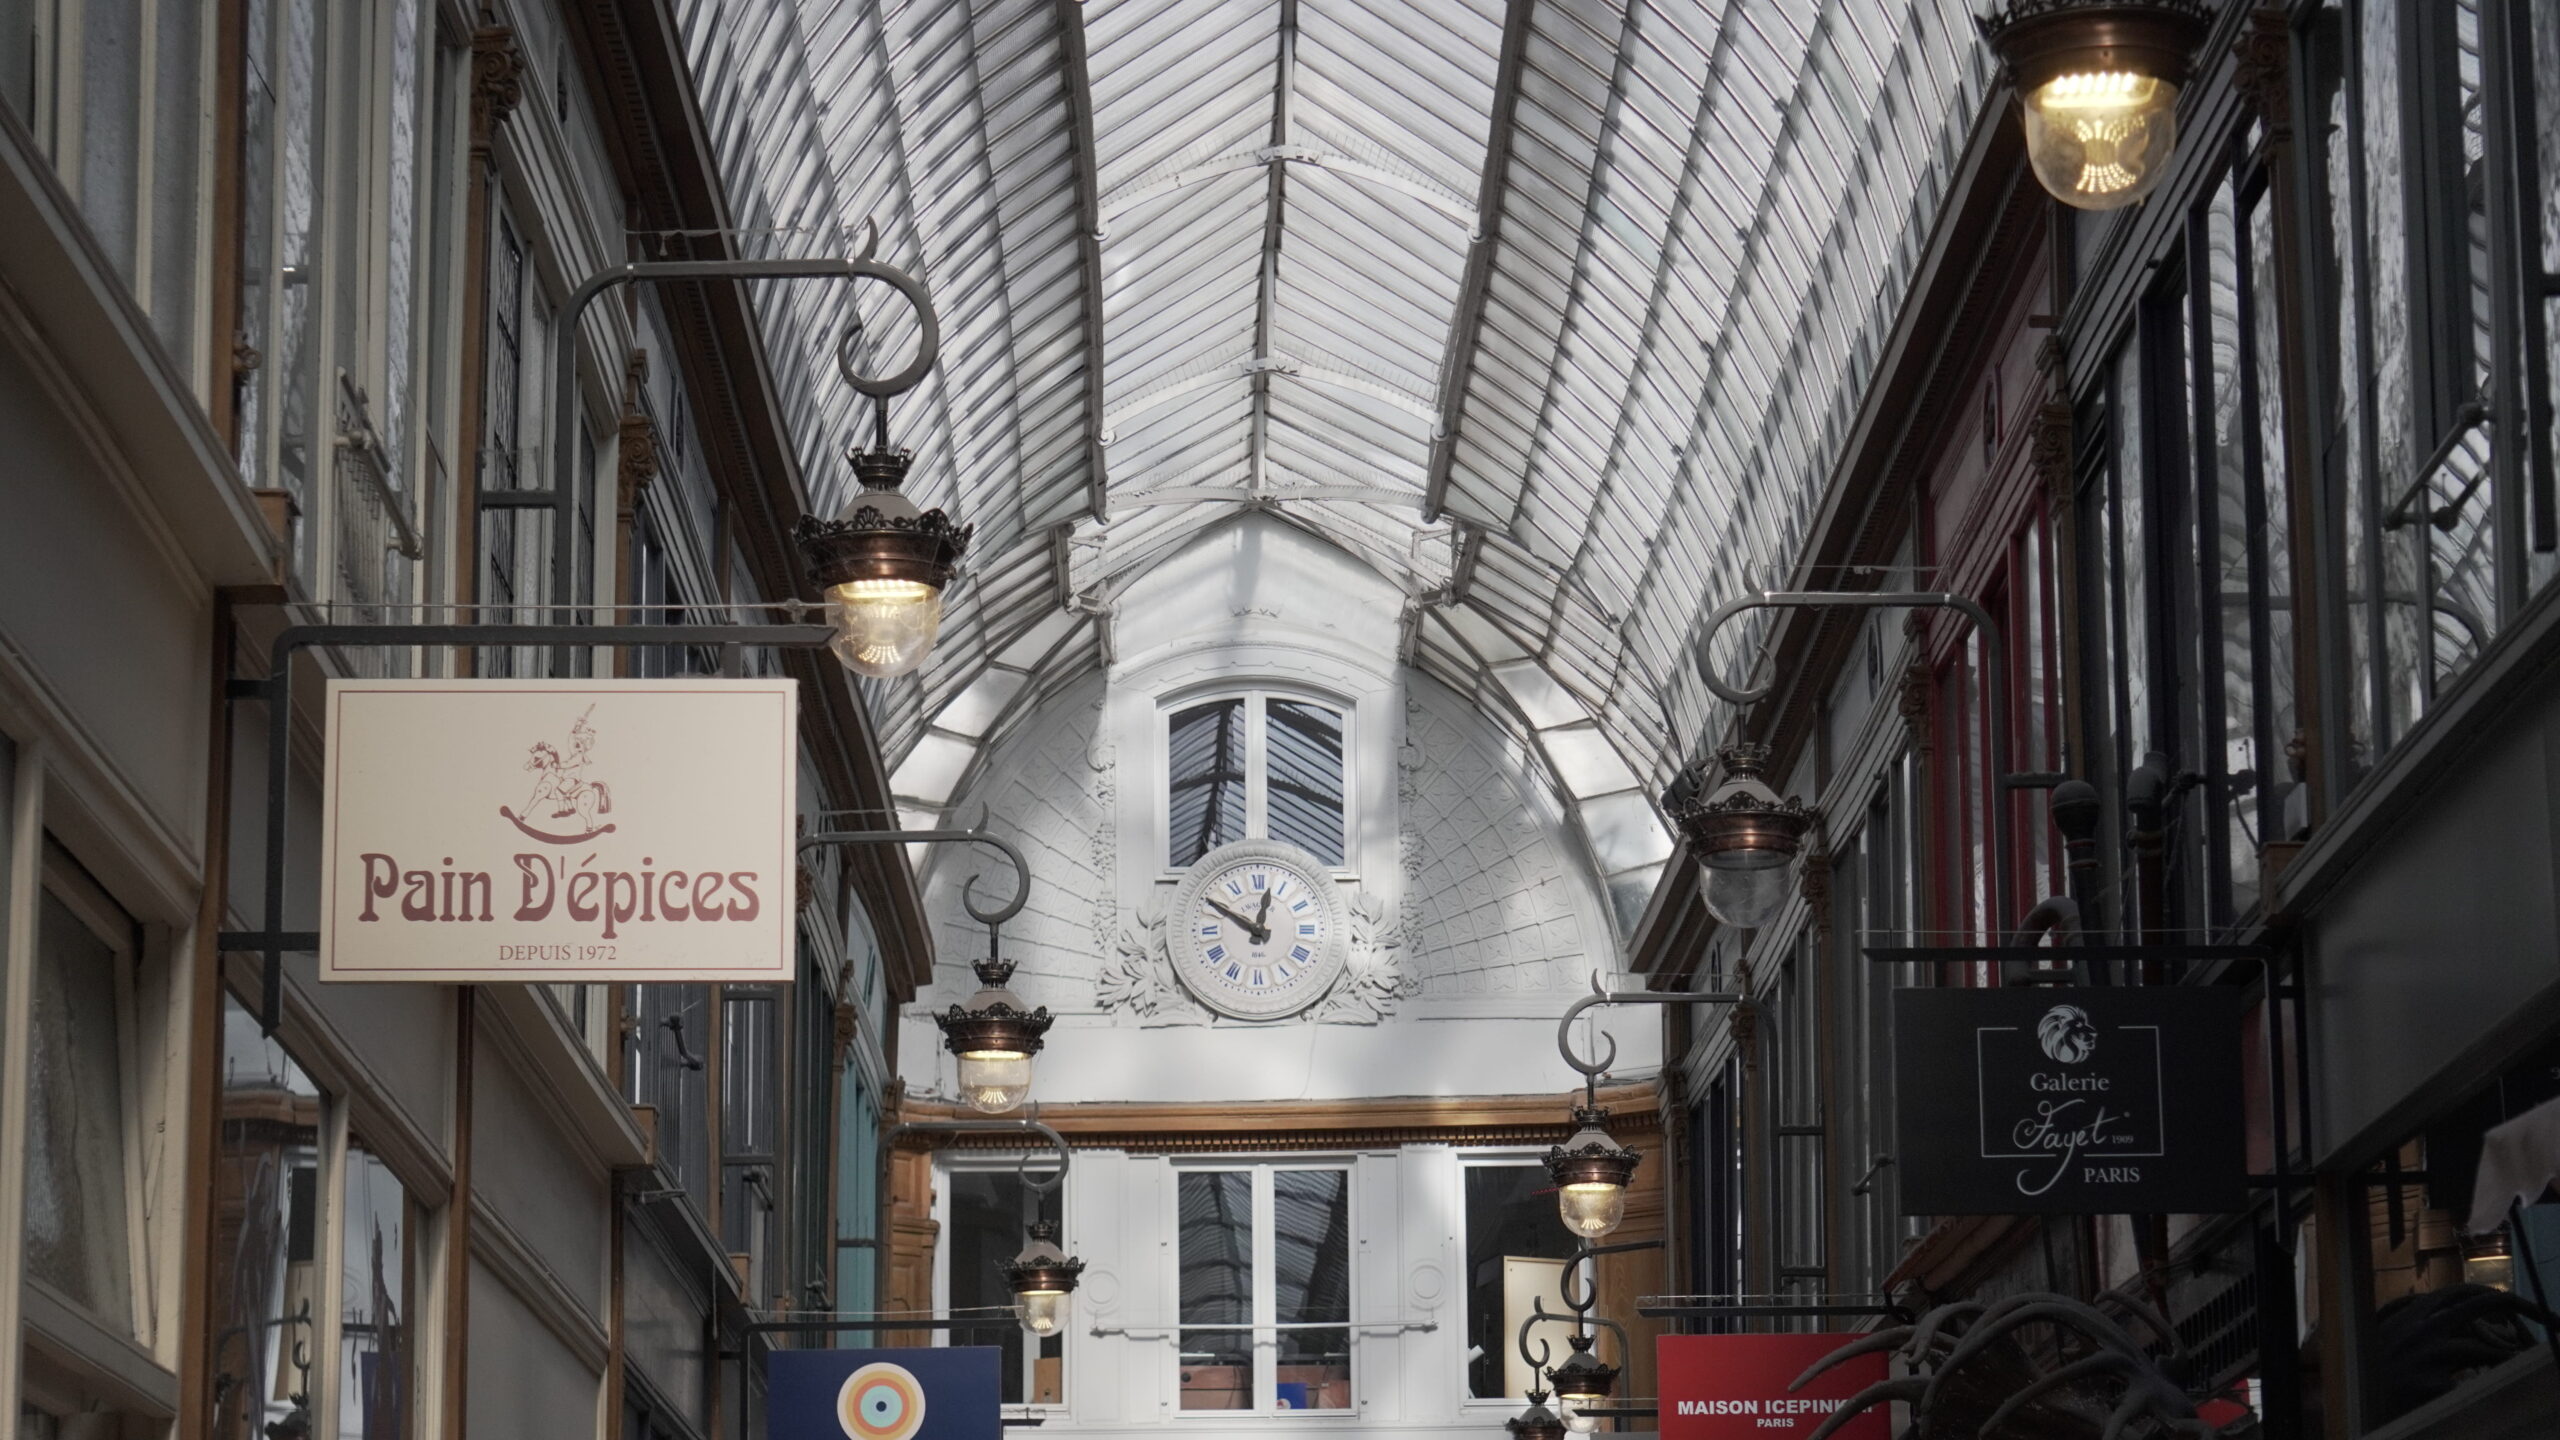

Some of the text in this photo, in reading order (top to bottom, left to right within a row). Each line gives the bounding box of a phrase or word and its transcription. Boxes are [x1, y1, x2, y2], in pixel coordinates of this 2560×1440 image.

[358, 853, 760, 940] Pain D'épices
[499, 945, 617, 961] DEPUIS 1972
[2030, 1072, 2110, 1092] Galerie
[2013, 1099, 2120, 1196] Fayet
[2084, 1167, 2140, 1183] PARIS
[1677, 1400, 1758, 1415] MAISON
[1757, 1418, 1794, 1428] PARIS
